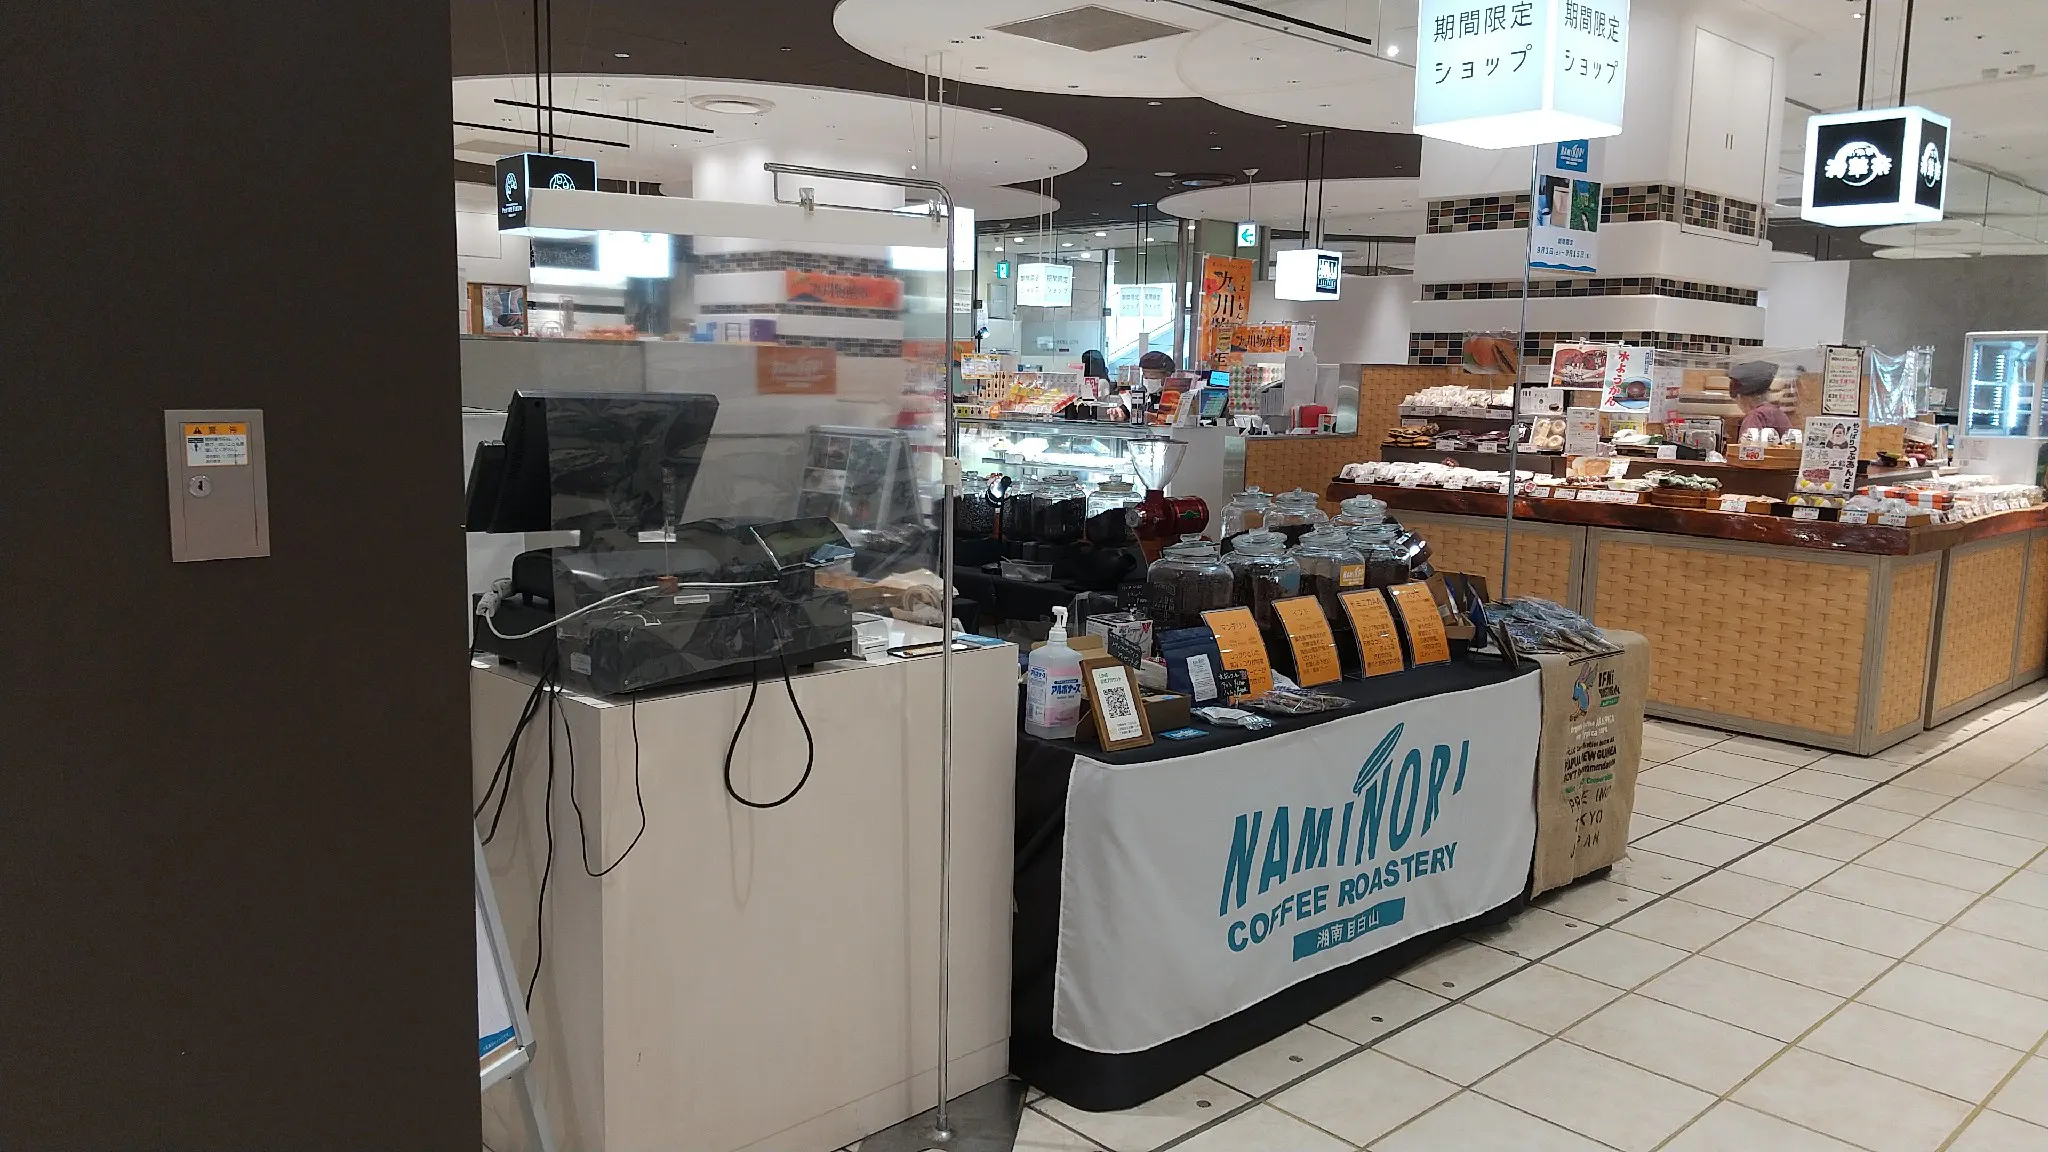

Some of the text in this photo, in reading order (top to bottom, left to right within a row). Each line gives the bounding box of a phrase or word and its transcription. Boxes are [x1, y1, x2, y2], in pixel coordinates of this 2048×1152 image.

[1434, 1, 1533, 42] 期間限定
[1564, 0, 1620, 43] 期間限定
[1435, 43, 1533, 84] ショップ
[1564, 50, 1619, 84] ショップ
[1604, 350, 1630, 407] 水ようかん
[1805, 448, 1829, 460] 究極
[1842, 421, 1860, 490] やっぱりつぶあんよね
[1220, 621, 1248, 631] マンデリン
[1050, 684, 1081, 695] アルボナース
[1219, 740, 1470, 917] NAMINORI
[1227, 842, 1458, 952] COFFEE ROASTERY
